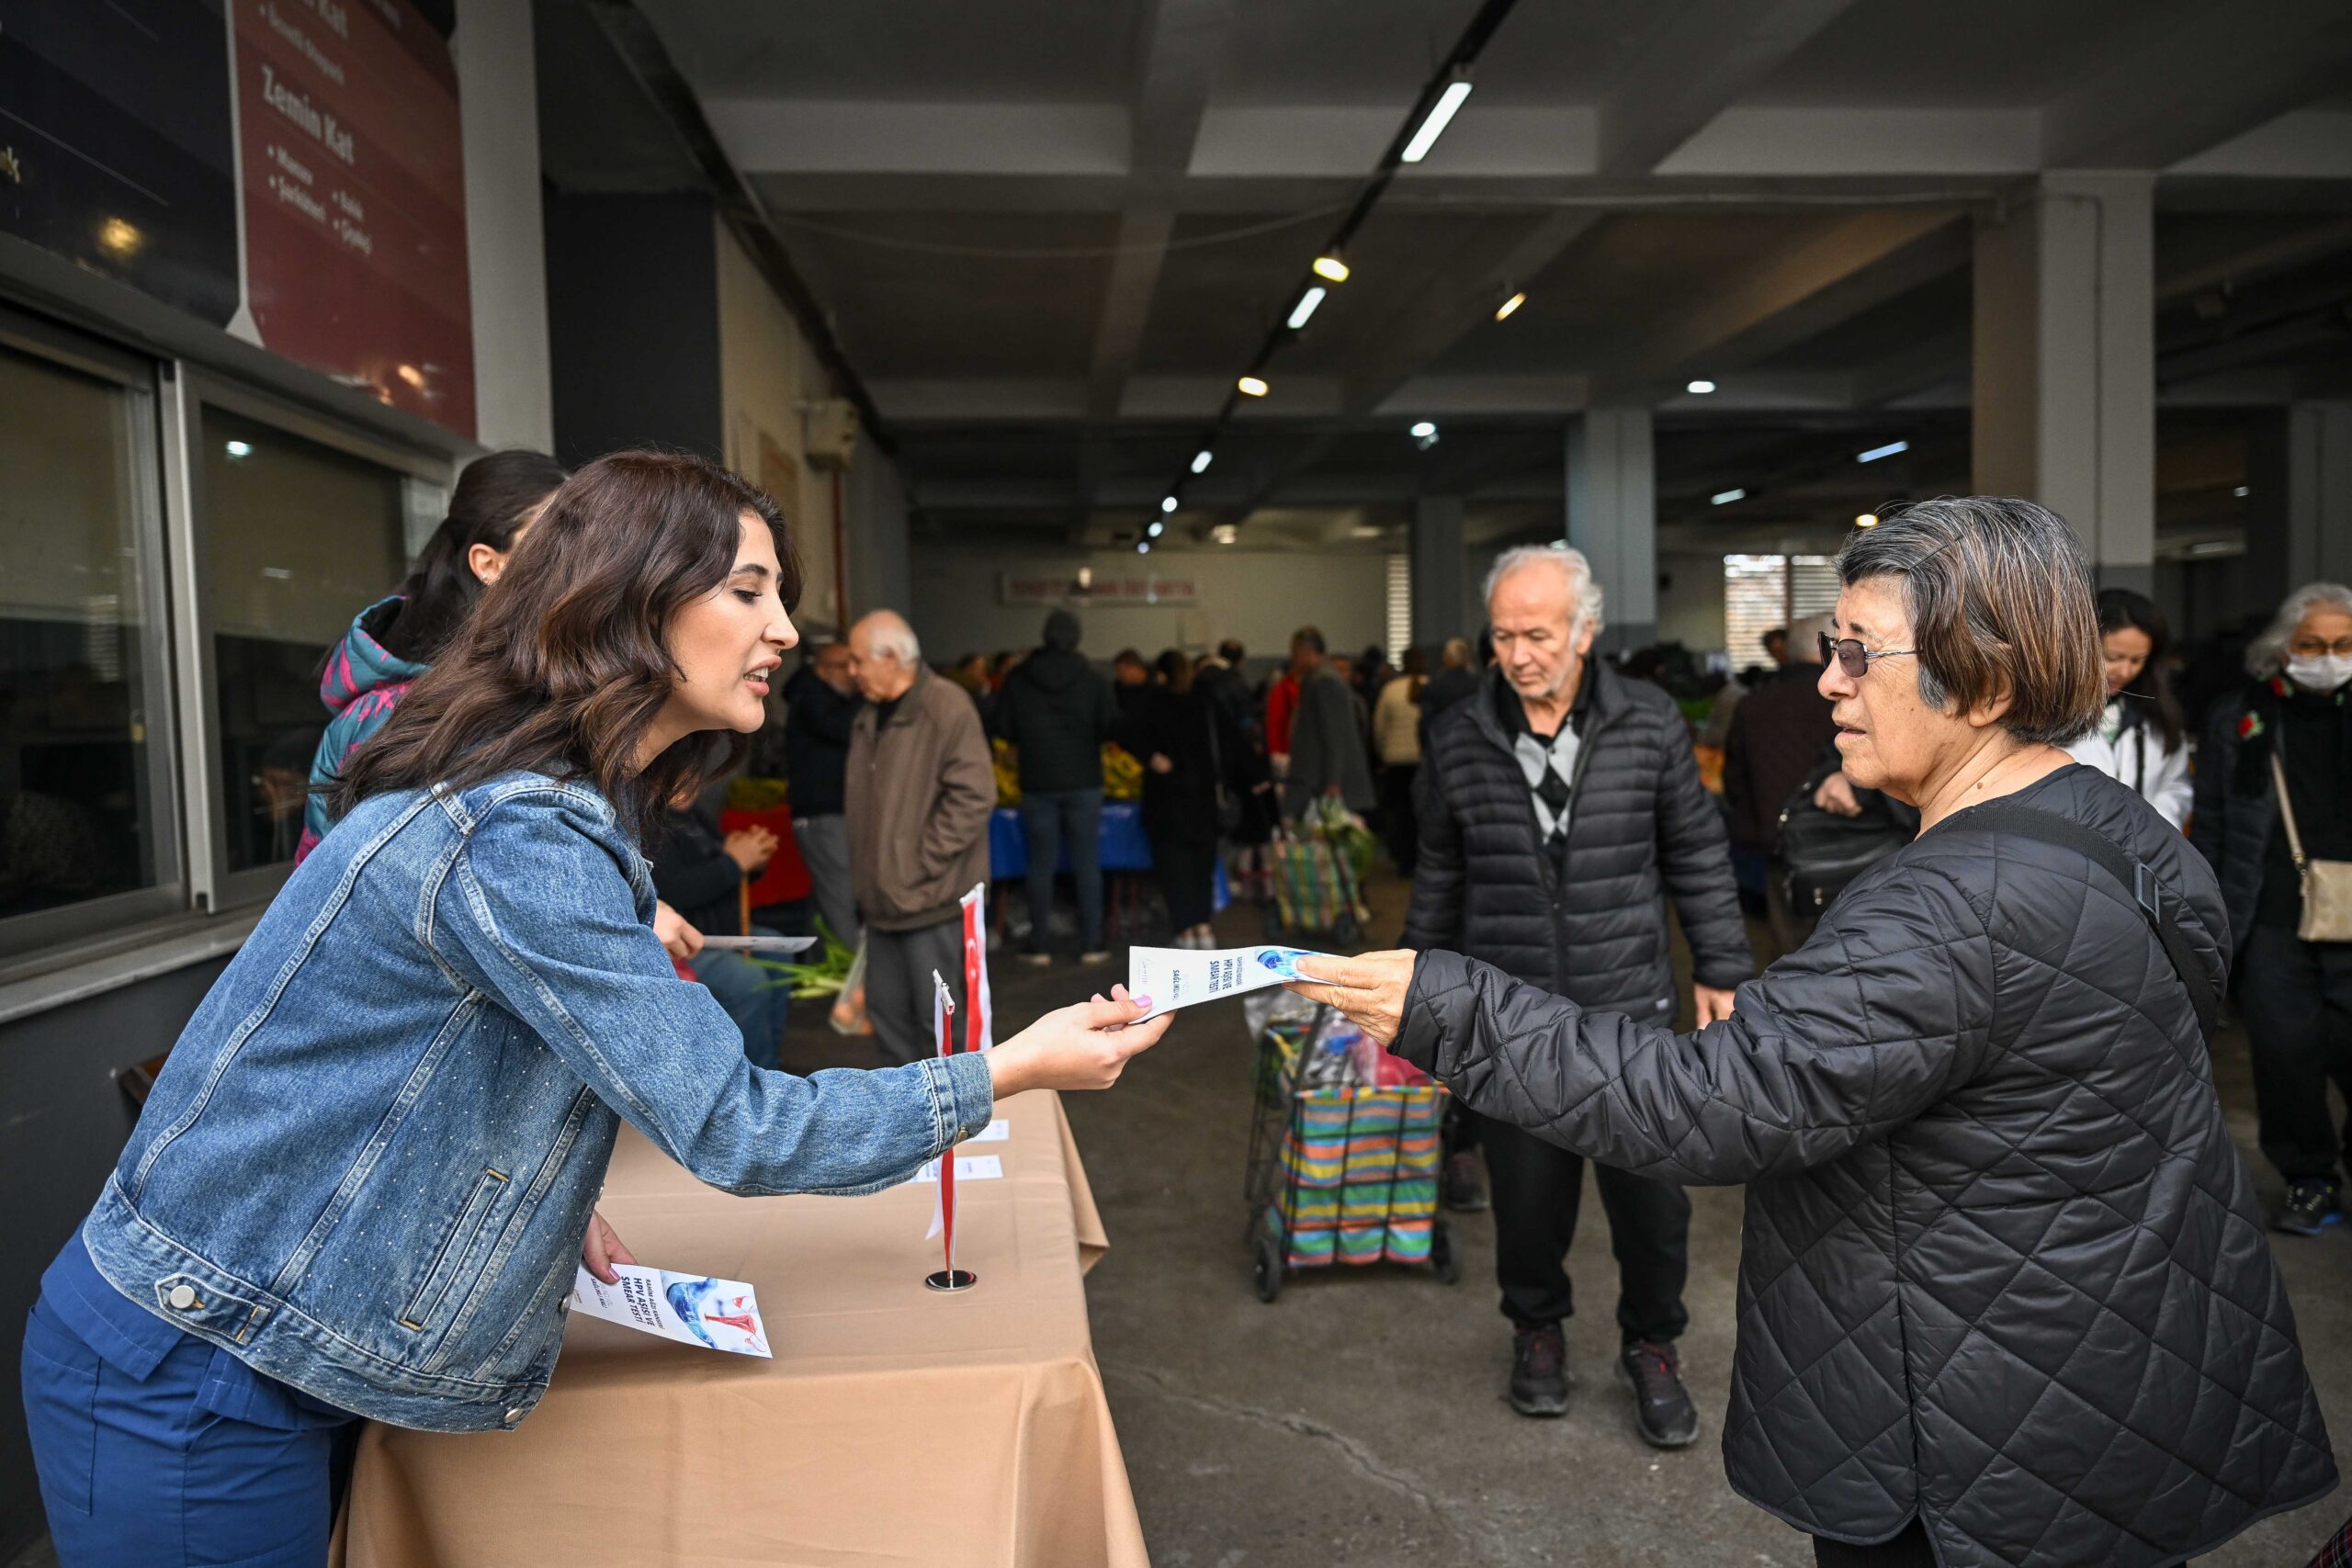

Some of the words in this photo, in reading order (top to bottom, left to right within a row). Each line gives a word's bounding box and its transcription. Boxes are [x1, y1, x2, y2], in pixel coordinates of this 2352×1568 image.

[262, 64, 322, 141] Zemin
[324, 113, 355, 164] Kat
[633, 1278, 644, 1295] HPV
[620, 1276, 636, 1303] SMEAR
[630, 1303, 646, 1324] TESTİ
[637, 1295, 650, 1318] AŞISI
[646, 1317, 655, 1327] VE
